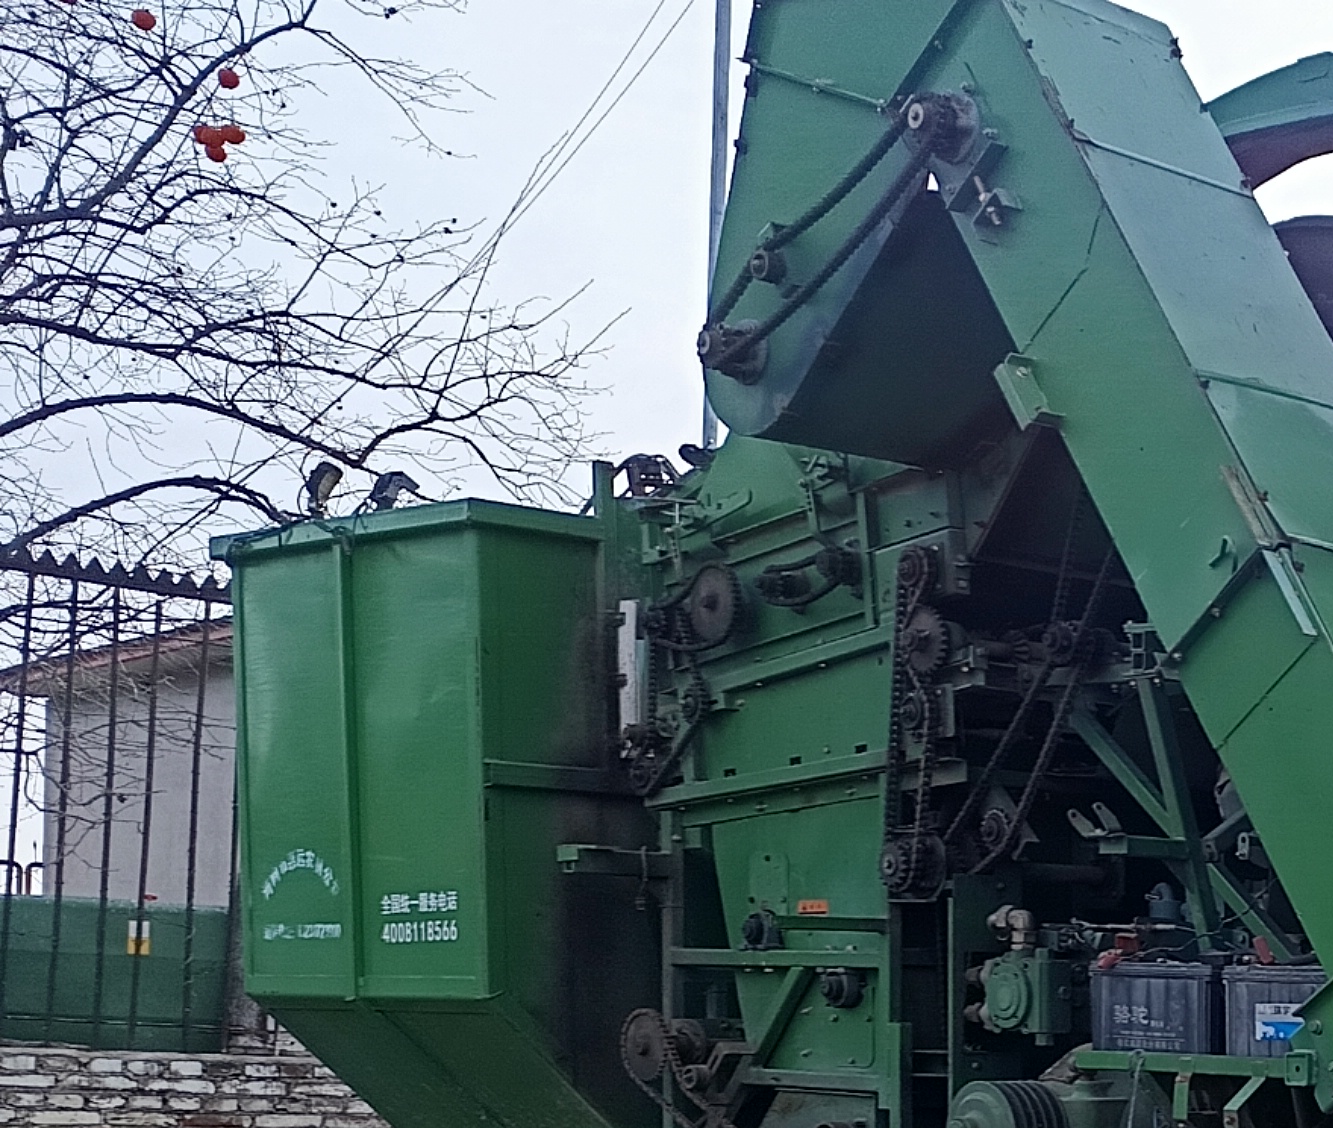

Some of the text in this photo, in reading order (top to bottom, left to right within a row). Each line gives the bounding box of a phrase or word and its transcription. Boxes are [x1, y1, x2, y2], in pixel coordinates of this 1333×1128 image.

[380, 890, 459, 915] 全国统一服务电话
[380, 919, 459, 943] 4008118566
